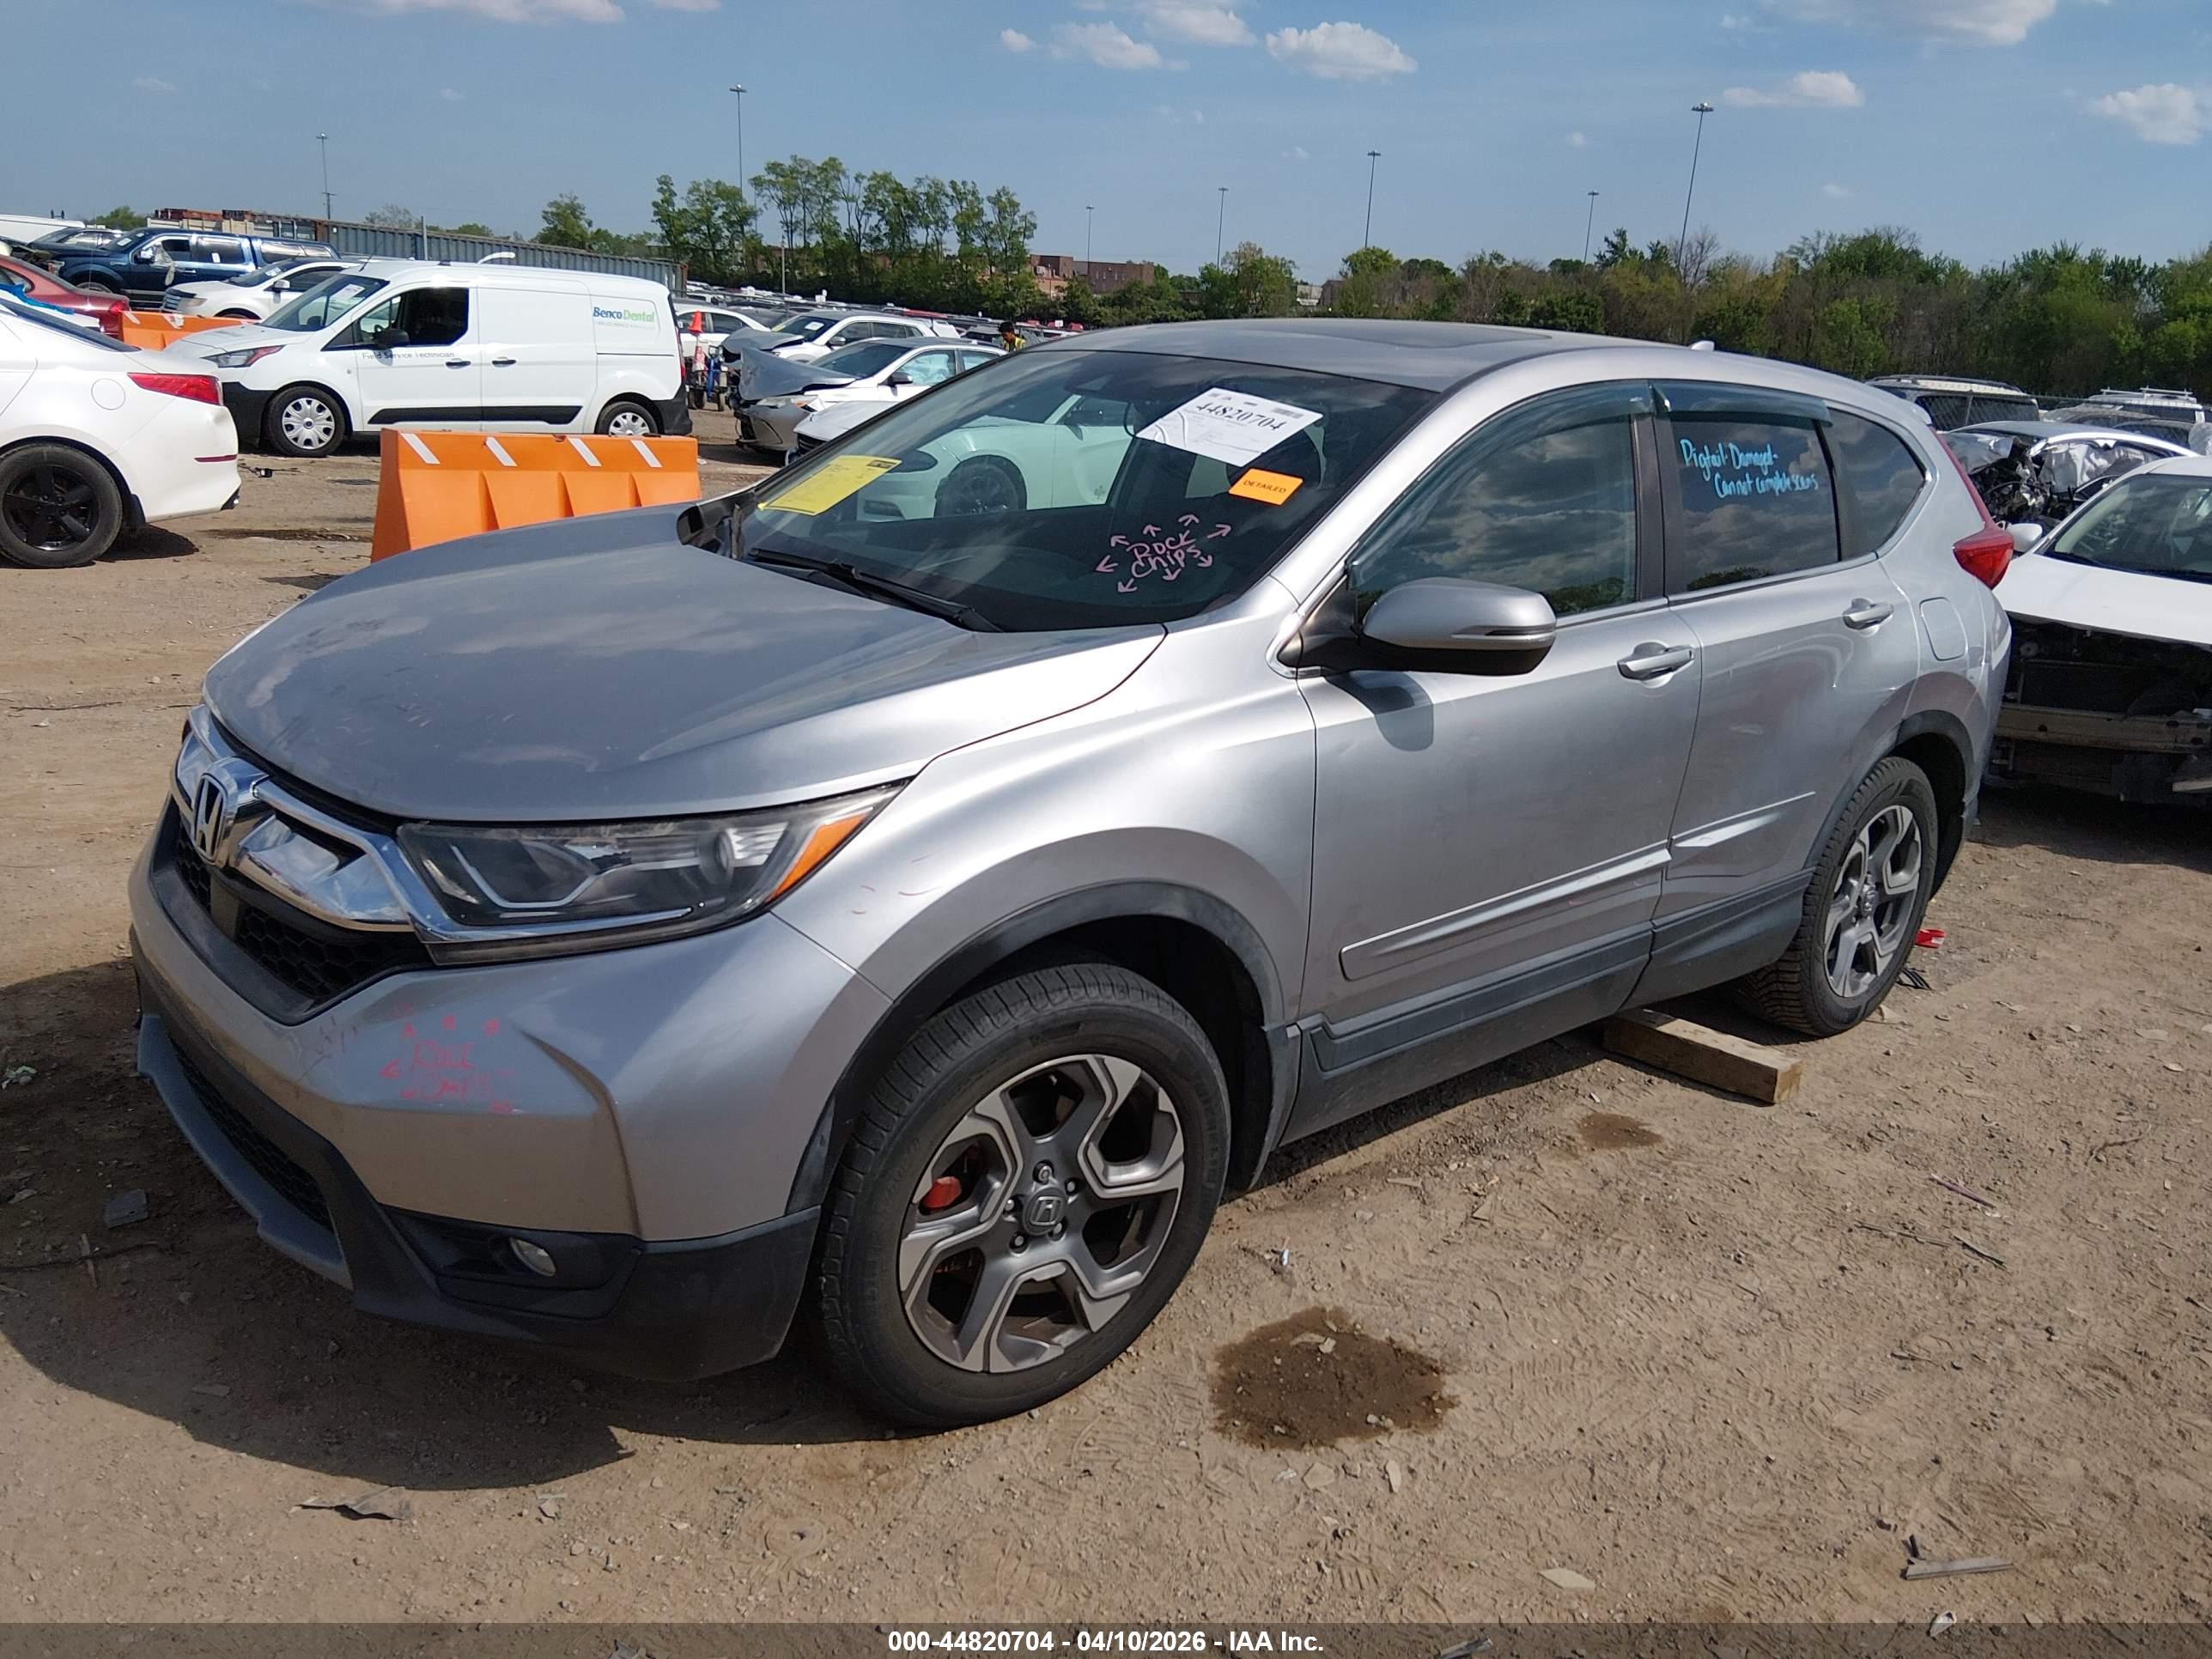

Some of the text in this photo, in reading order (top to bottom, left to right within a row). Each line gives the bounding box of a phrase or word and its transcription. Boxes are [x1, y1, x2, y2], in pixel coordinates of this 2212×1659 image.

[592, 307, 654, 322] Benco Dental
[1196, 402, 1287, 431] 44820704
[1243, 480, 1286, 493] DETAILED
